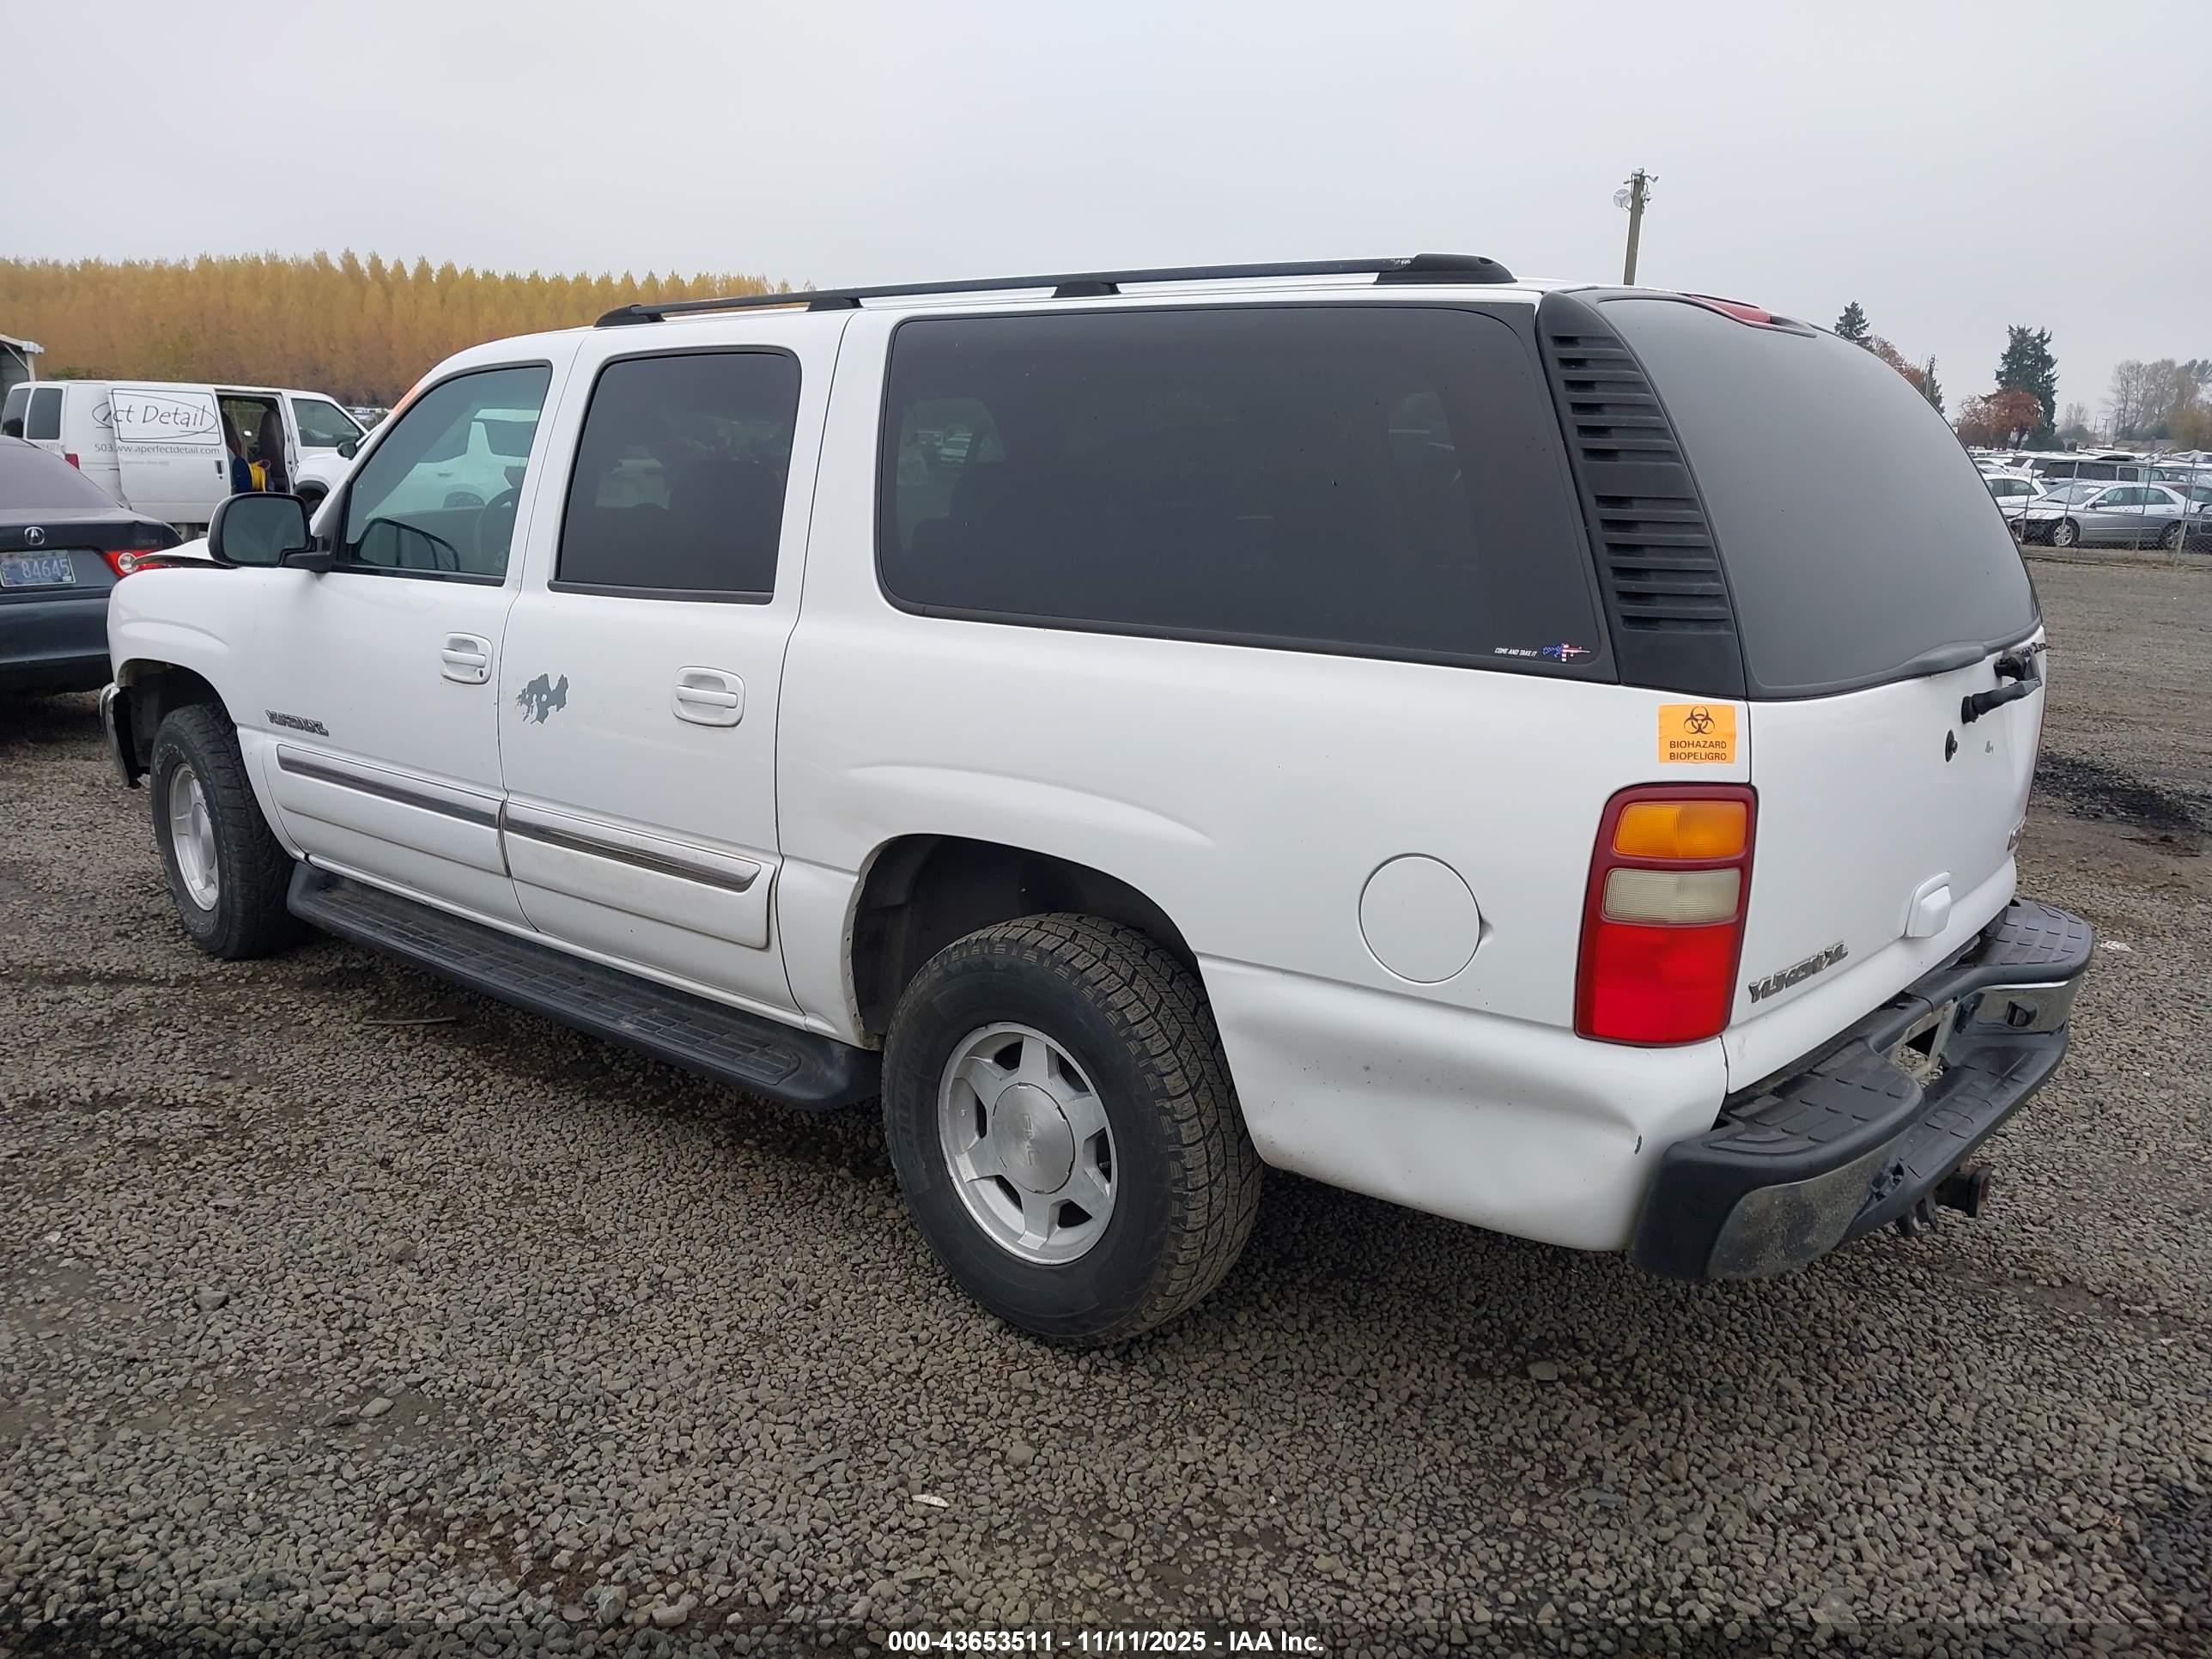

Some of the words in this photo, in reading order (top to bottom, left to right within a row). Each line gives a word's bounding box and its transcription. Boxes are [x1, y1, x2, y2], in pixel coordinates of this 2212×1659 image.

[143, 405, 205, 428] Detail
[21, 559, 70, 578] 84645
[1669, 740, 1727, 749] BIOHAZARD
[1669, 752, 1727, 761] BIOPELIGRO
